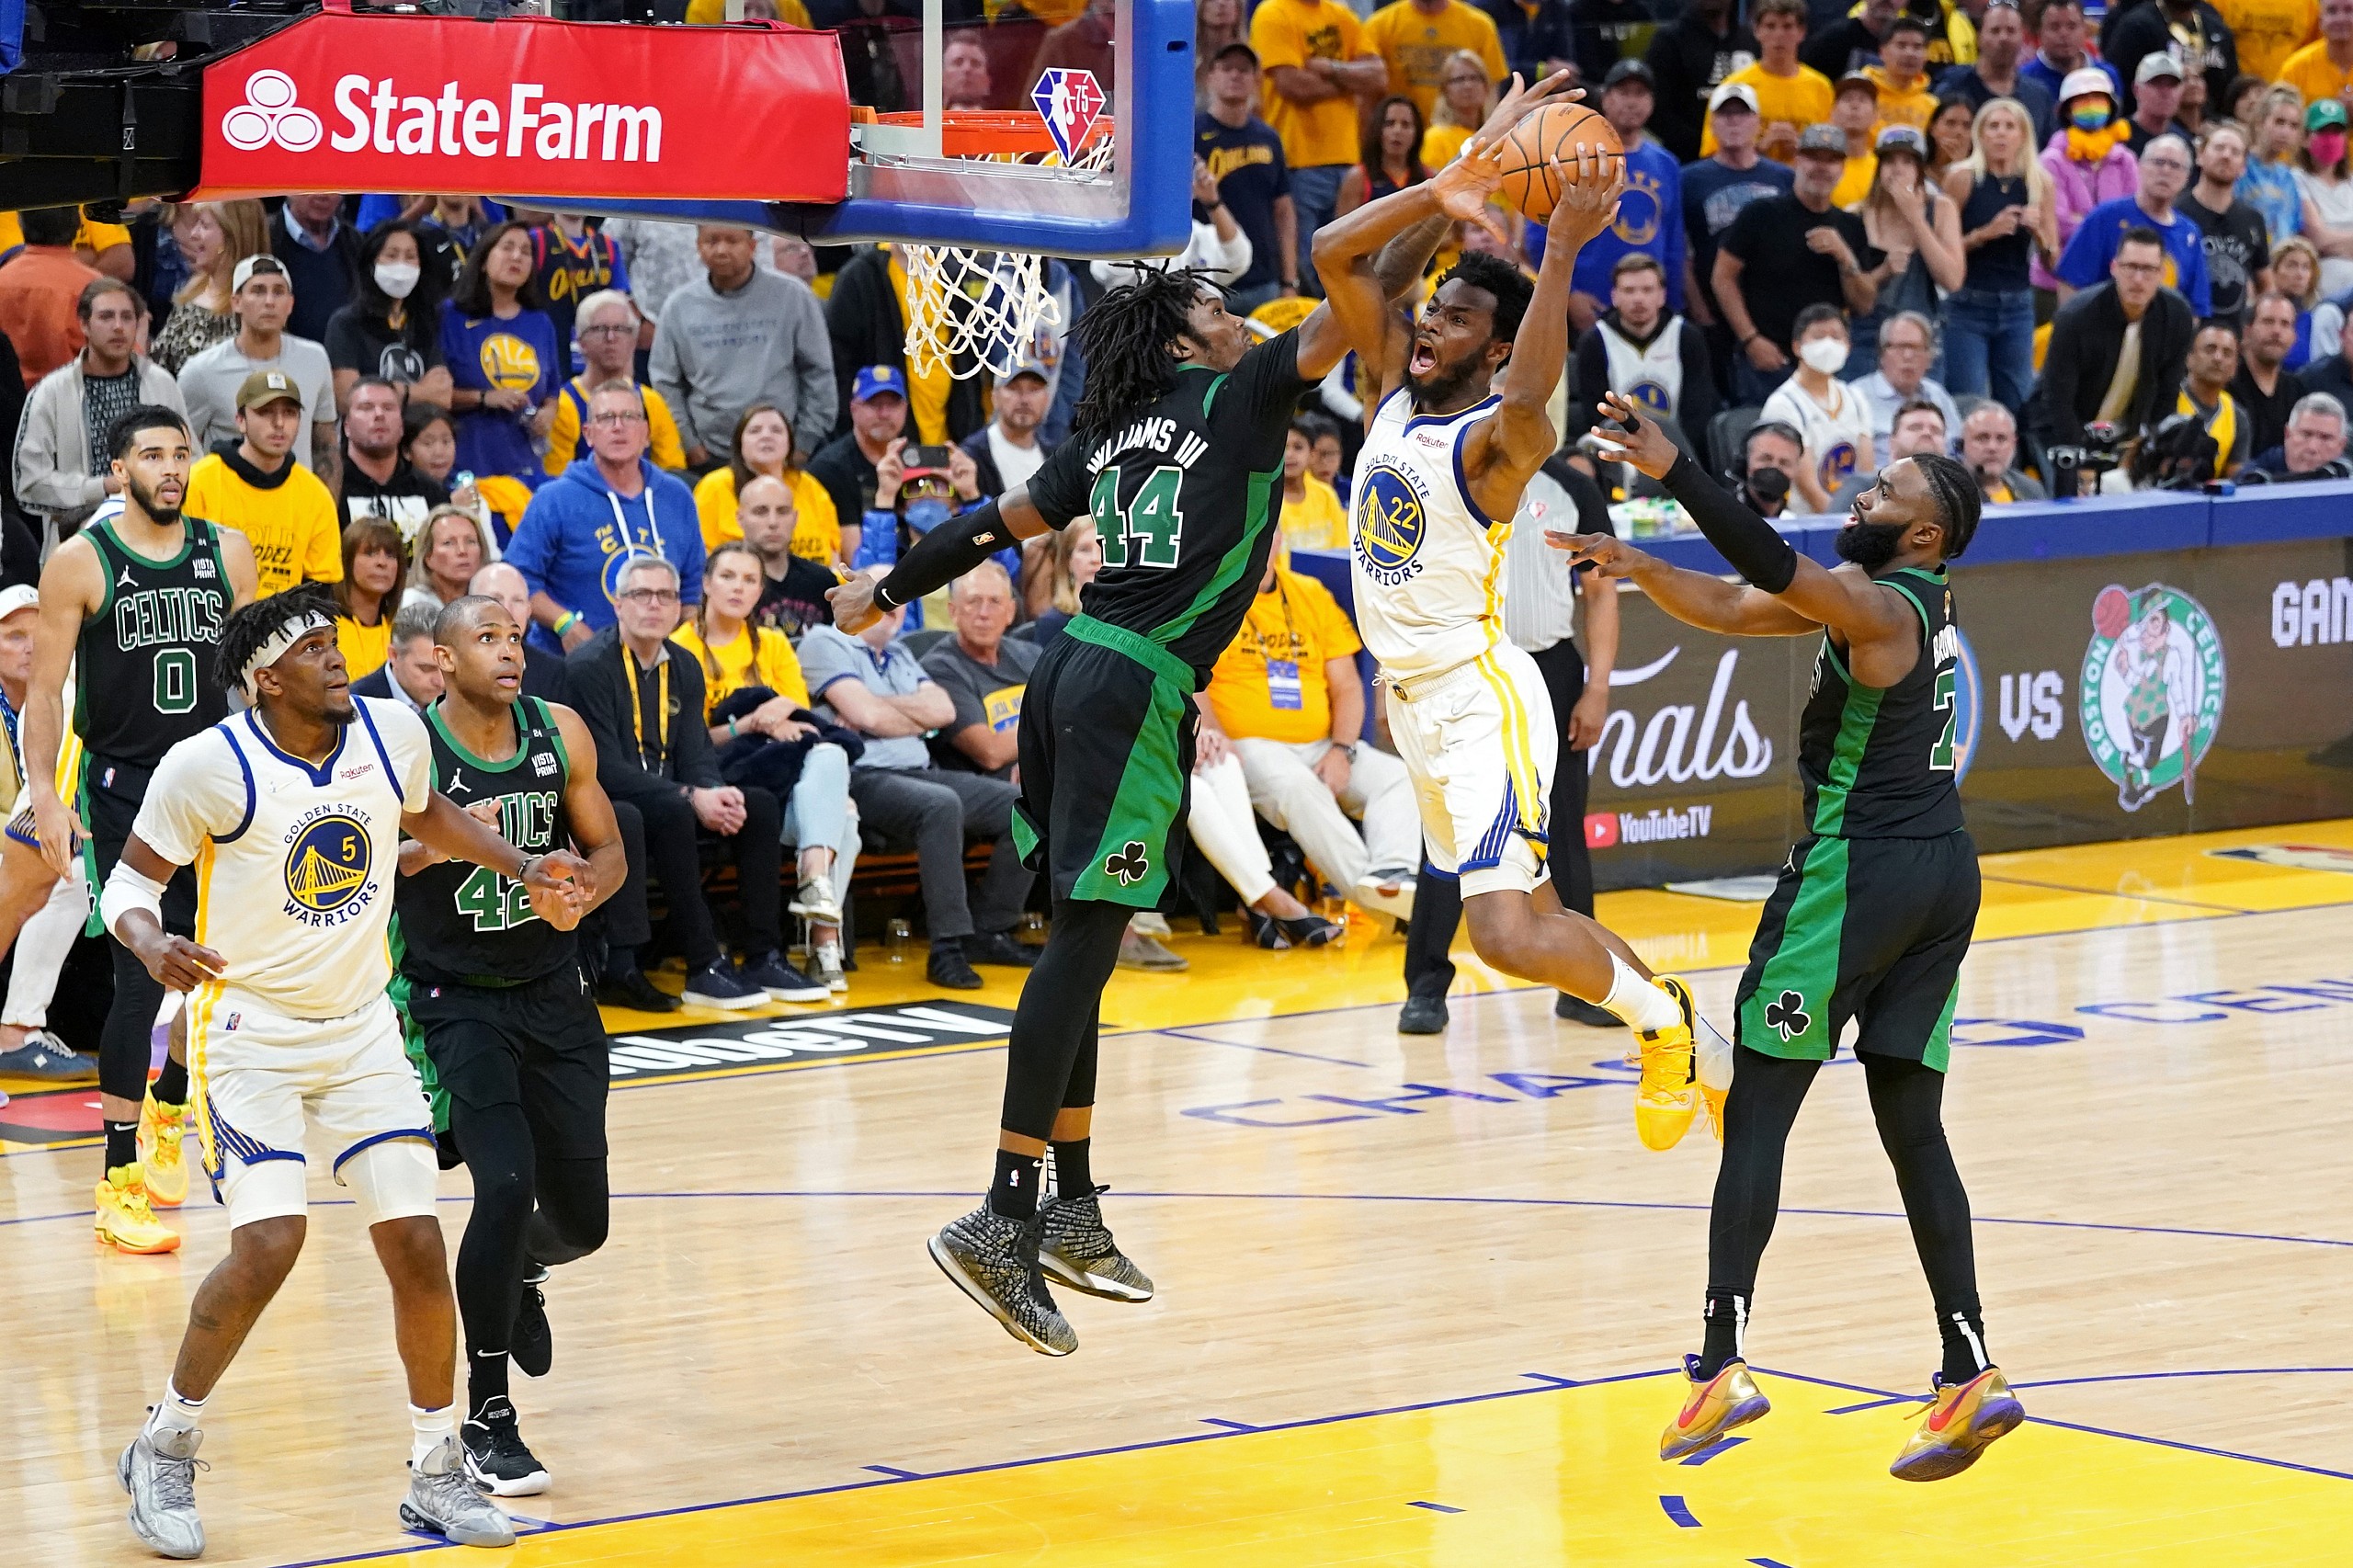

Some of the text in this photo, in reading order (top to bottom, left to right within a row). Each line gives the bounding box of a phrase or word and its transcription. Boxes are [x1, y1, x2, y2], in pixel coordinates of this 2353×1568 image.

[1074, 85, 1090, 113] 75
[1086, 416, 1177, 482] WILLIAMS
[1415, 433, 1449, 449] Rakuten
[1399, 461, 1430, 500] STATE
[1088, 465, 1184, 569] 44
[1389, 496, 1419, 531] 22
[192, 557, 216, 571] VISTA
[194, 569, 216, 580] PRINT
[1352, 530, 1424, 587] WARRIORS
[115, 586, 223, 652] CELTICS
[153, 647, 198, 715] 0
[2186, 611, 2221, 730] CELTICS
[1585, 645, 1774, 789] nals
[1928, 667, 1957, 771] 7
[1998, 669, 2064, 743] VS
[2084, 639, 2114, 763] BOSTON
[340, 763, 375, 780] Rakuten
[531, 752, 555, 769] VISTA
[535, 764, 558, 778] PRINT
[283, 802, 372, 845] GOLDEN STATE
[460, 790, 558, 851] TICS
[341, 835, 357, 862] 5
[282, 881, 380, 928] WARRIORS
[453, 856, 546, 933] 42
